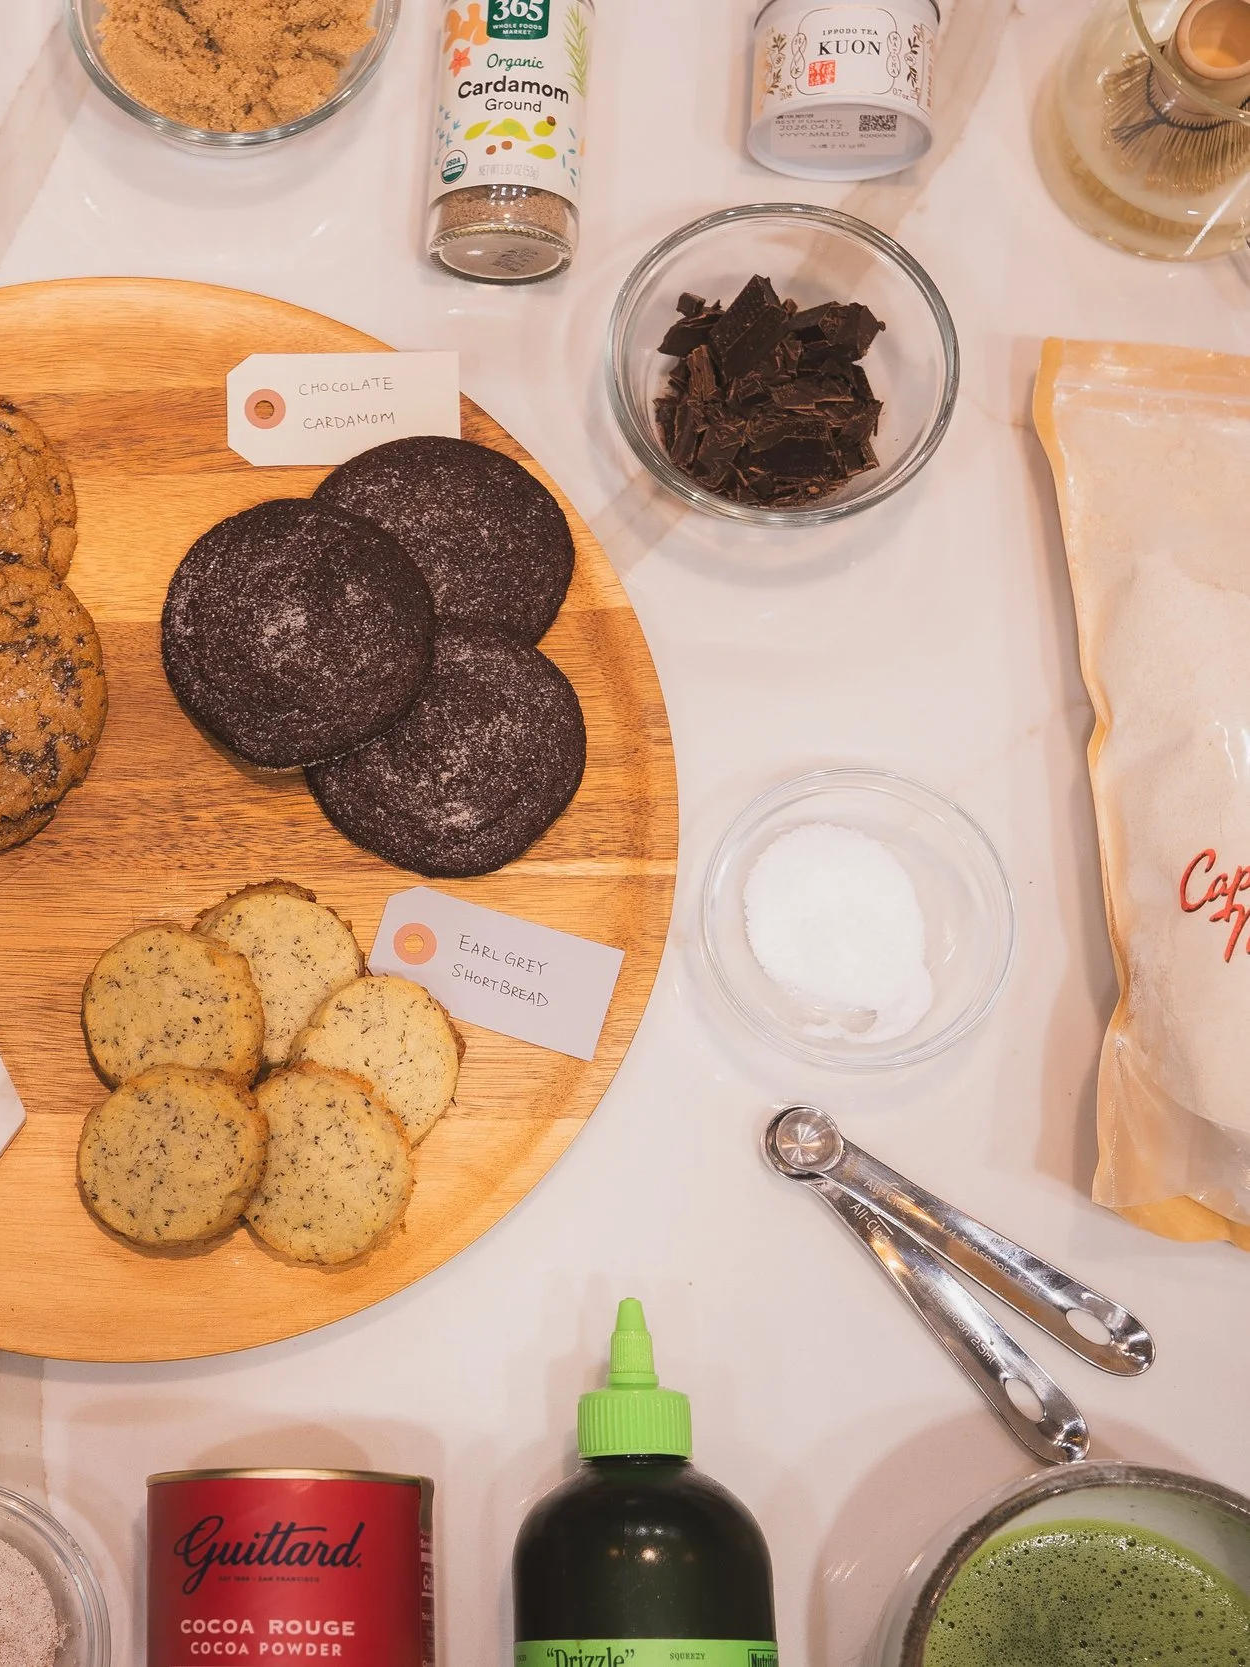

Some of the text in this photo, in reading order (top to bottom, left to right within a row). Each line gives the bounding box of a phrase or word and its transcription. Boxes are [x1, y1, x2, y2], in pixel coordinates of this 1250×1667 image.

[493, 0, 543, 21] 365
[519, 23, 543, 31] FOODS
[822, 28, 879, 37] IPPODO TEA
[817, 39, 884, 56] KUON
[486, 53, 545, 72] Organic
[457, 76, 569, 105] Cardamom
[484, 98, 543, 113] Ground
[298, 376, 395, 396] CHOCOLATE
[303, 411, 396, 431] CARDAMOM
[458, 933, 550, 976] EARL GREY
[960, 1235, 1012, 1276] Teaspoon
[180, 1619, 356, 1636] COCOA ROUGE
[190, 1641, 343, 1657] COCOA POWDER
[669, 1651, 707, 1661] SQUEEZY
